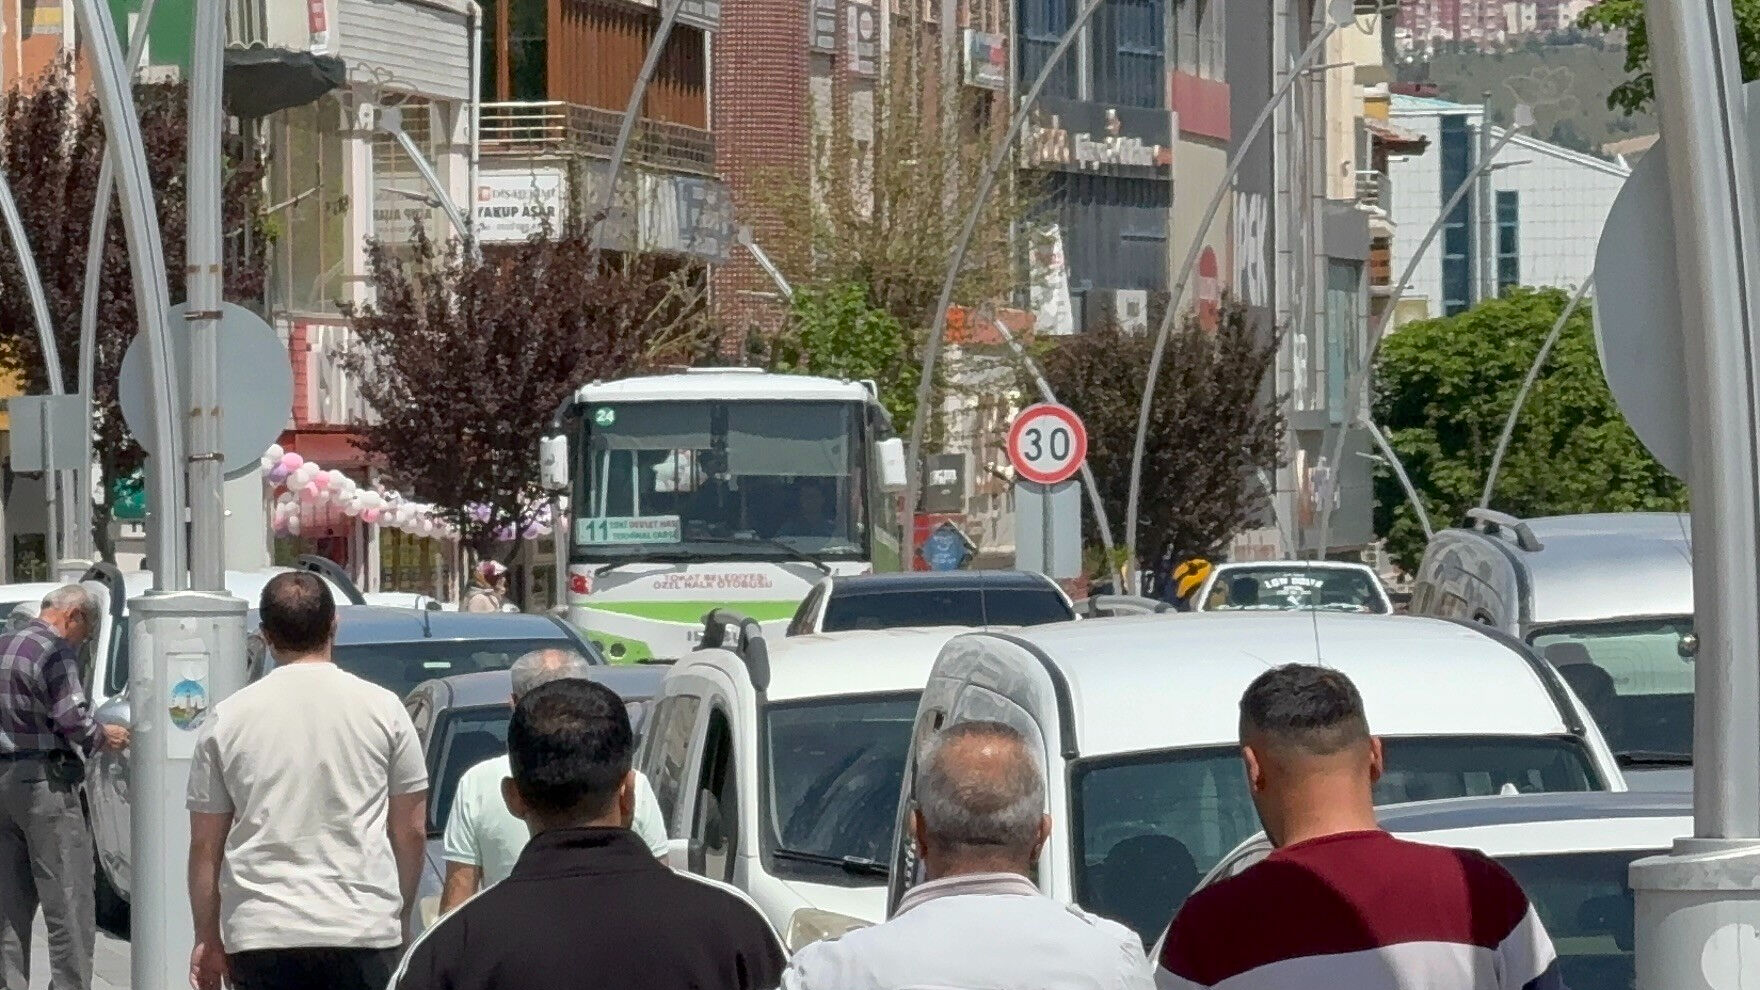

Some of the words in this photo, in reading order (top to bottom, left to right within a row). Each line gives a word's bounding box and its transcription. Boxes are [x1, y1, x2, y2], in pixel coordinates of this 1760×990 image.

[596, 408, 616, 423] 24
[1024, 427, 1070, 462] 30
[585, 520, 608, 541] 11
